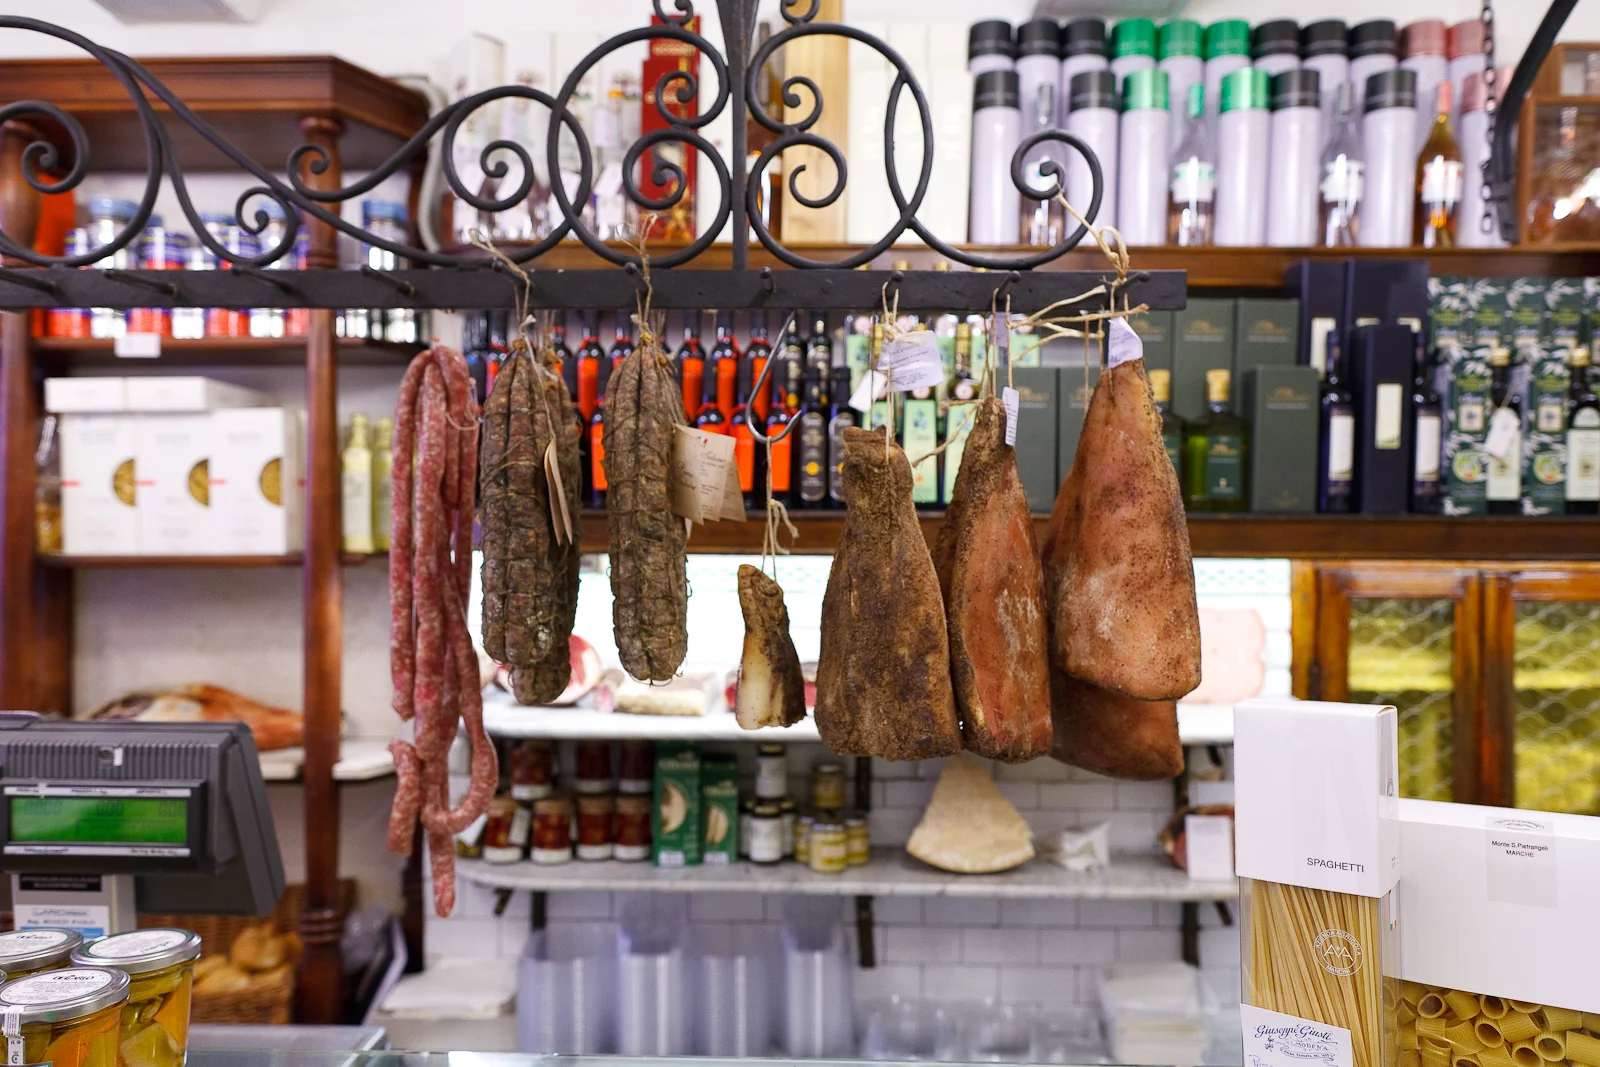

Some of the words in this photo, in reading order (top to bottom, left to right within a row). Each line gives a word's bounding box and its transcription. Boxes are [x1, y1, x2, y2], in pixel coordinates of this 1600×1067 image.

[1491, 840, 1510, 848] Monte
[1505, 849, 1535, 857] MARCHE
[1307, 857, 1364, 873] SPAGHETTI
[1253, 1024, 1298, 1040] Giuseppe
[1295, 1024, 1333, 1040] Giusti
